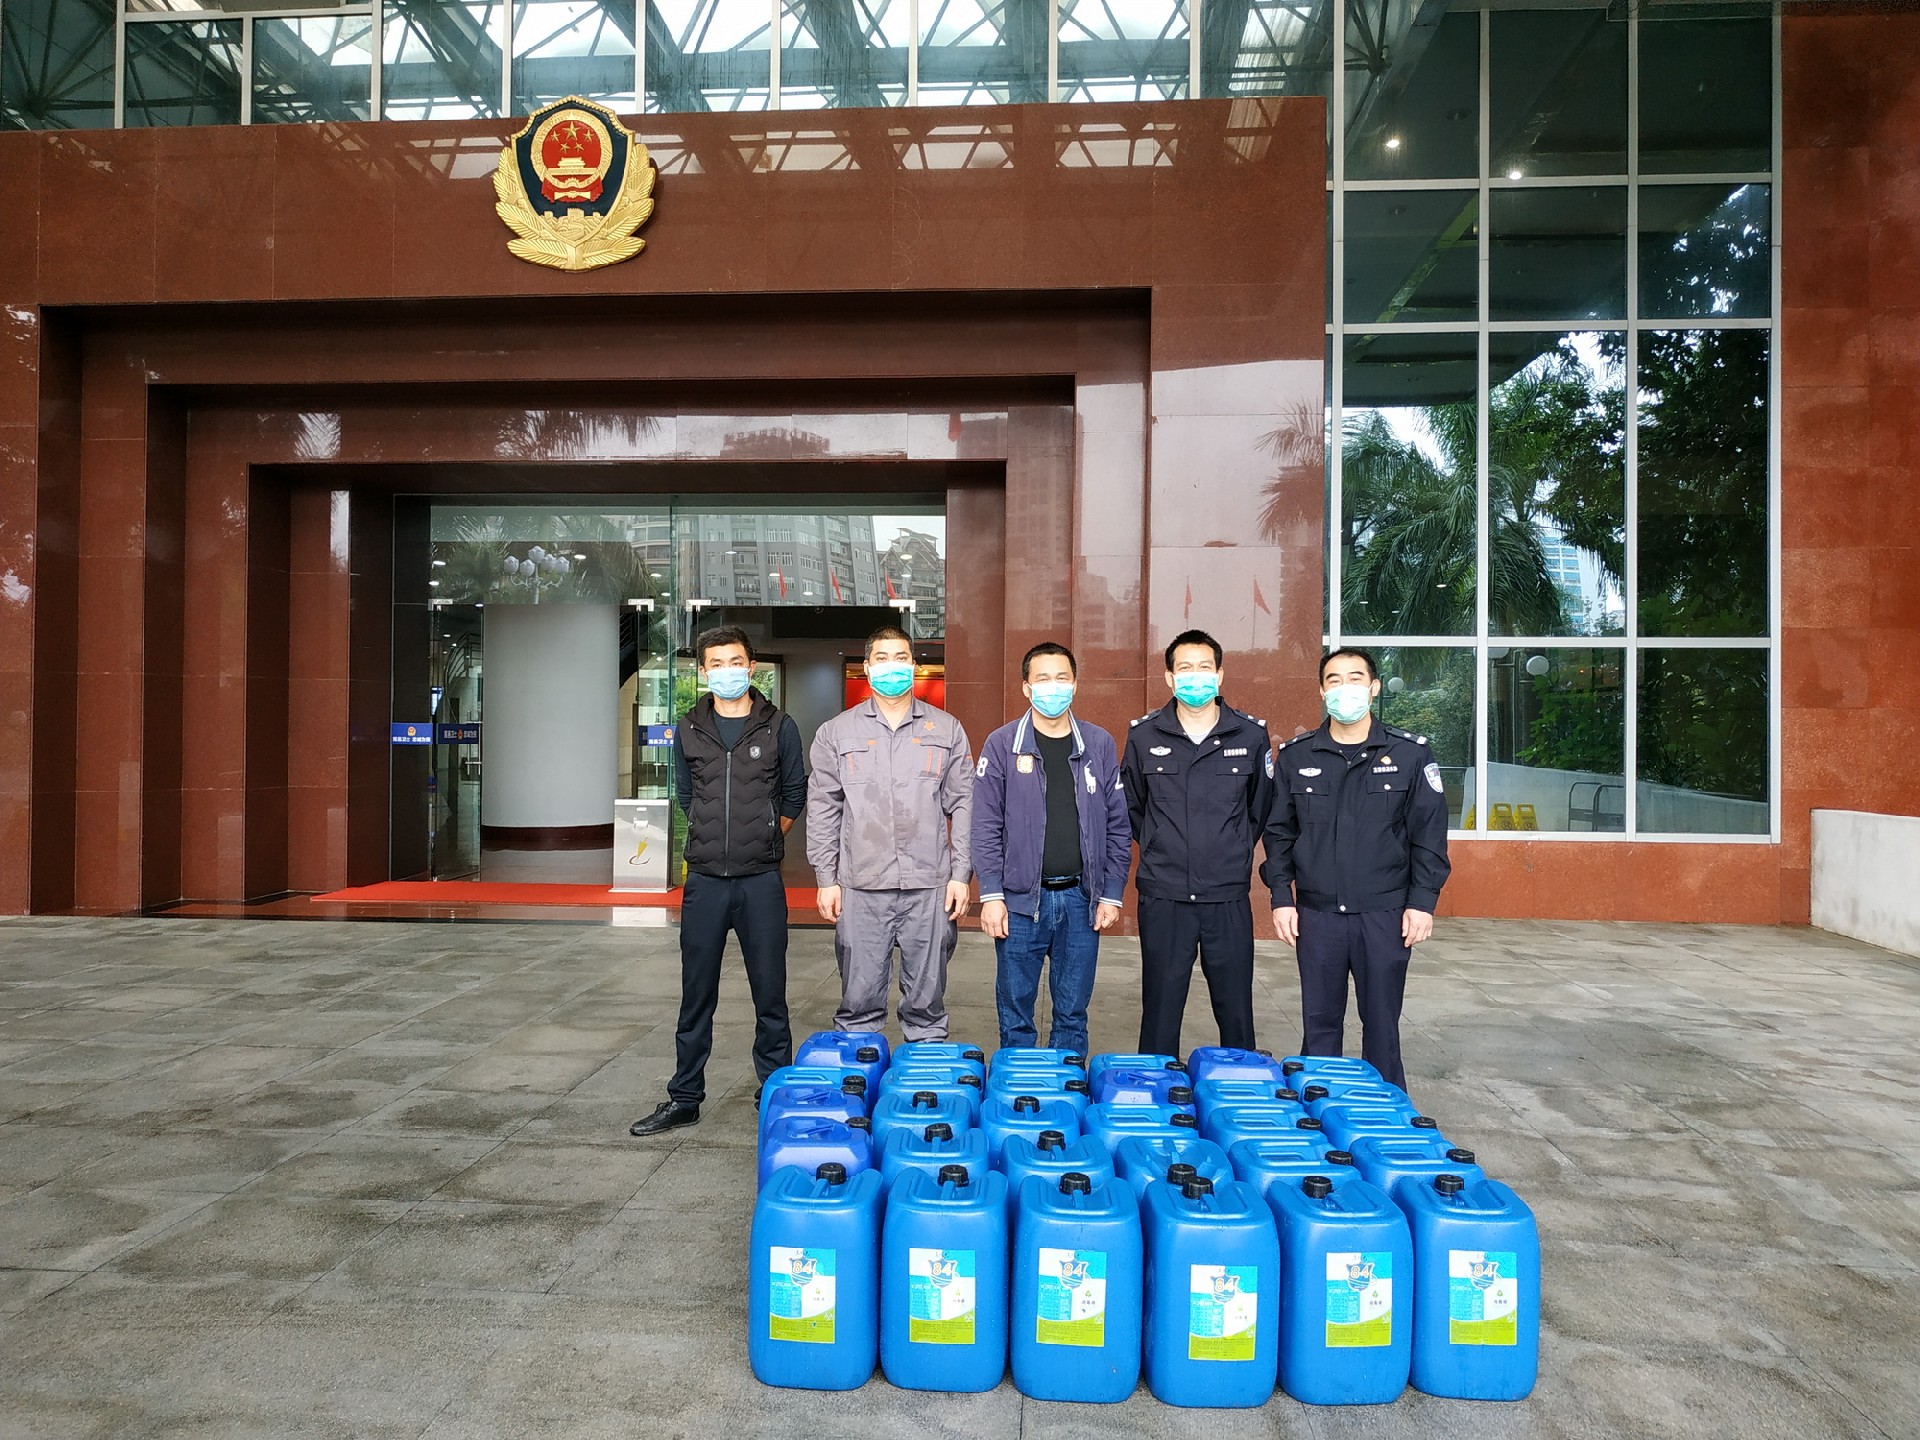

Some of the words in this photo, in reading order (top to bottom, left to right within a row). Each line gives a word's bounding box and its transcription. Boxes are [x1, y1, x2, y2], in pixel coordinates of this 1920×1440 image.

[793, 1260, 813, 1274] 84
[933, 1262, 952, 1276] 84
[1063, 1263, 1083, 1277] 84
[1350, 1265, 1370, 1279] 84
[1473, 1263, 1494, 1277] 84
[1215, 1277, 1235, 1292] 84
